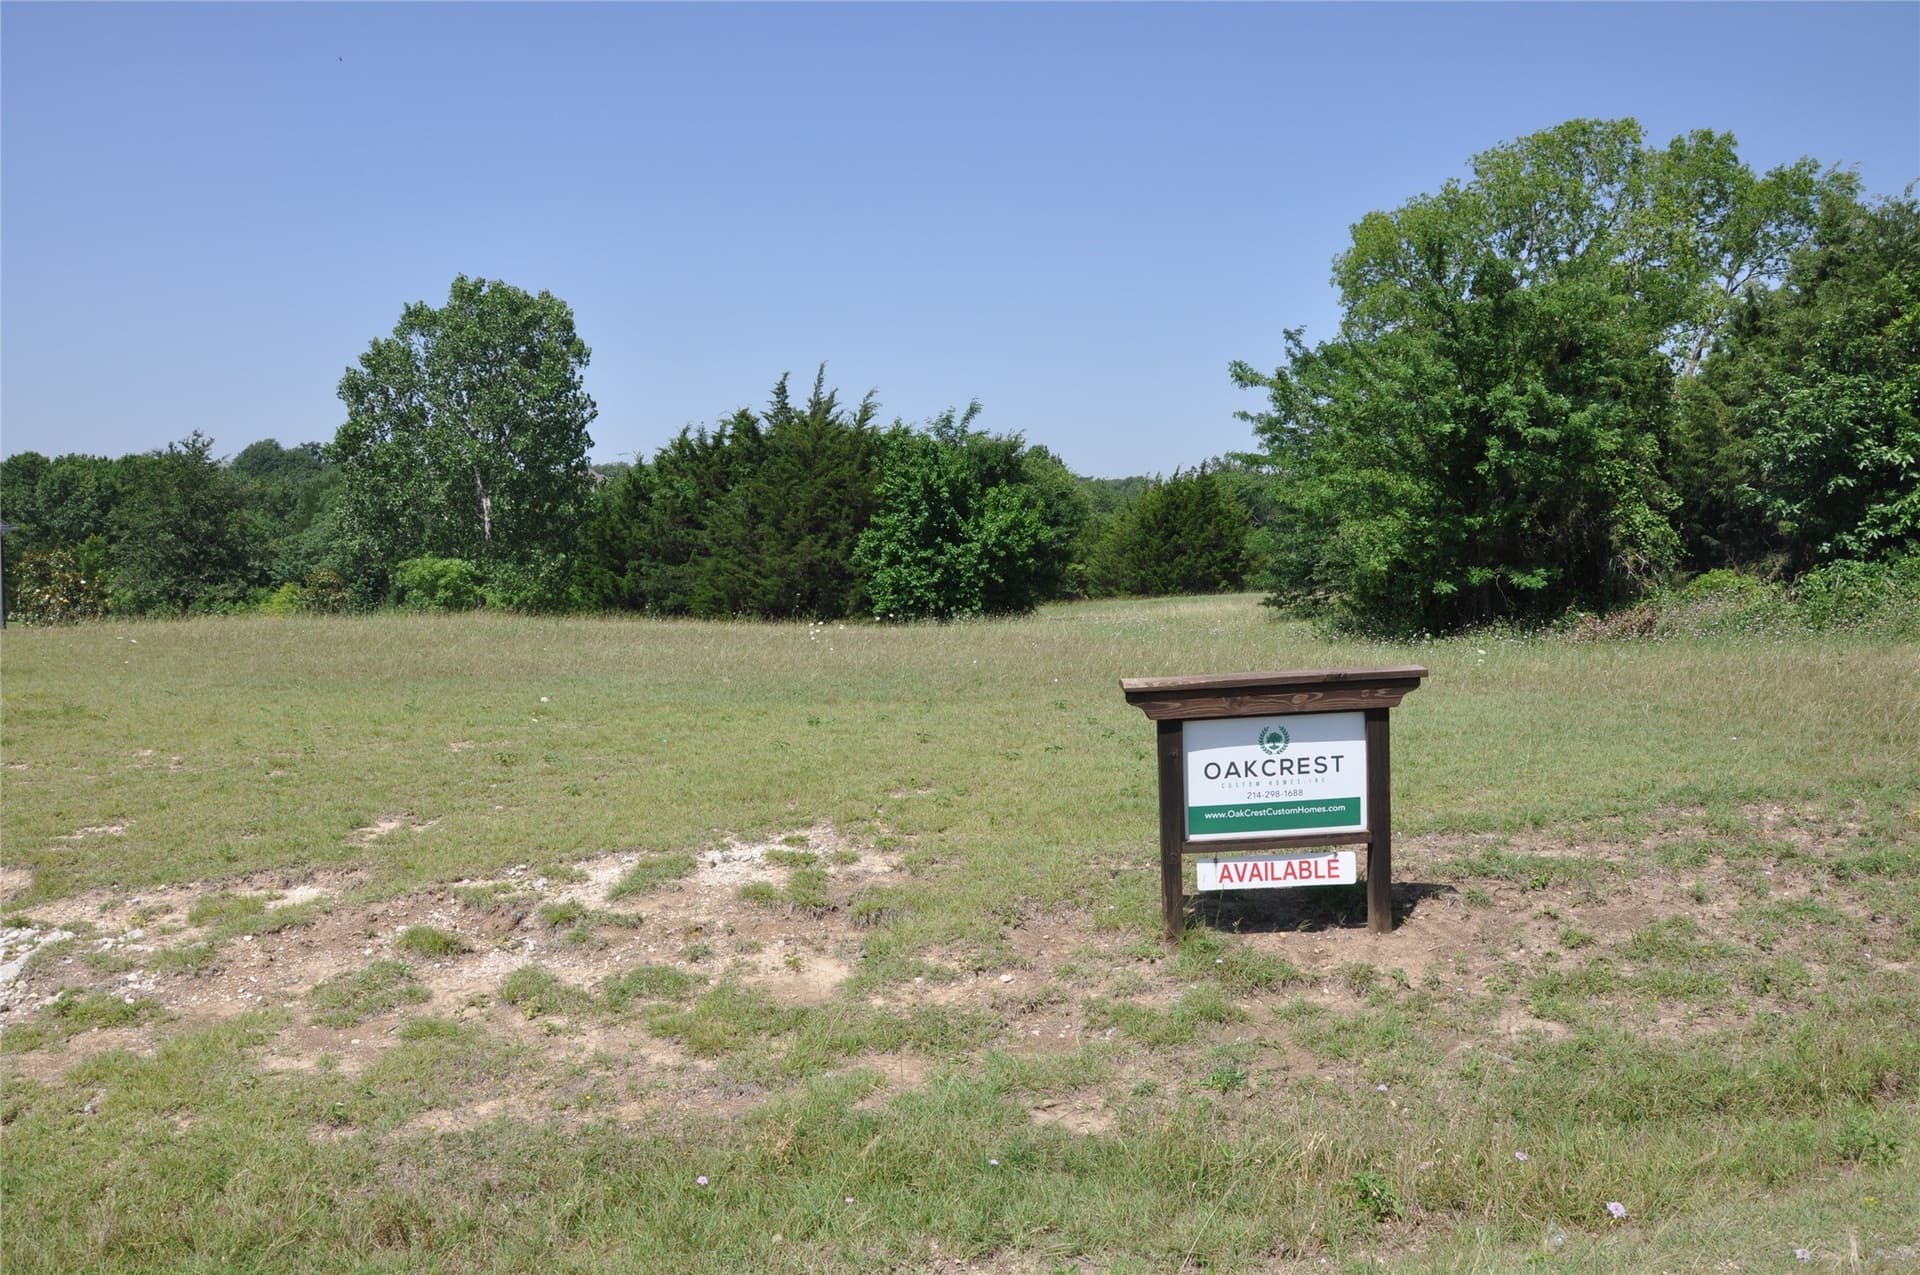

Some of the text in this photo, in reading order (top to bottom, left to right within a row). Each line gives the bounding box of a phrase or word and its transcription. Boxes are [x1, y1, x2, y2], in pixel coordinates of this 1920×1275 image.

[1204, 755, 1344, 779] OAKCREST
[1247, 789, 1304, 799] 214-298-1688
[1204, 804, 1346, 819] www.OakCrestCustomHomes.com
[1218, 859, 1340, 884] AVAILABLE
